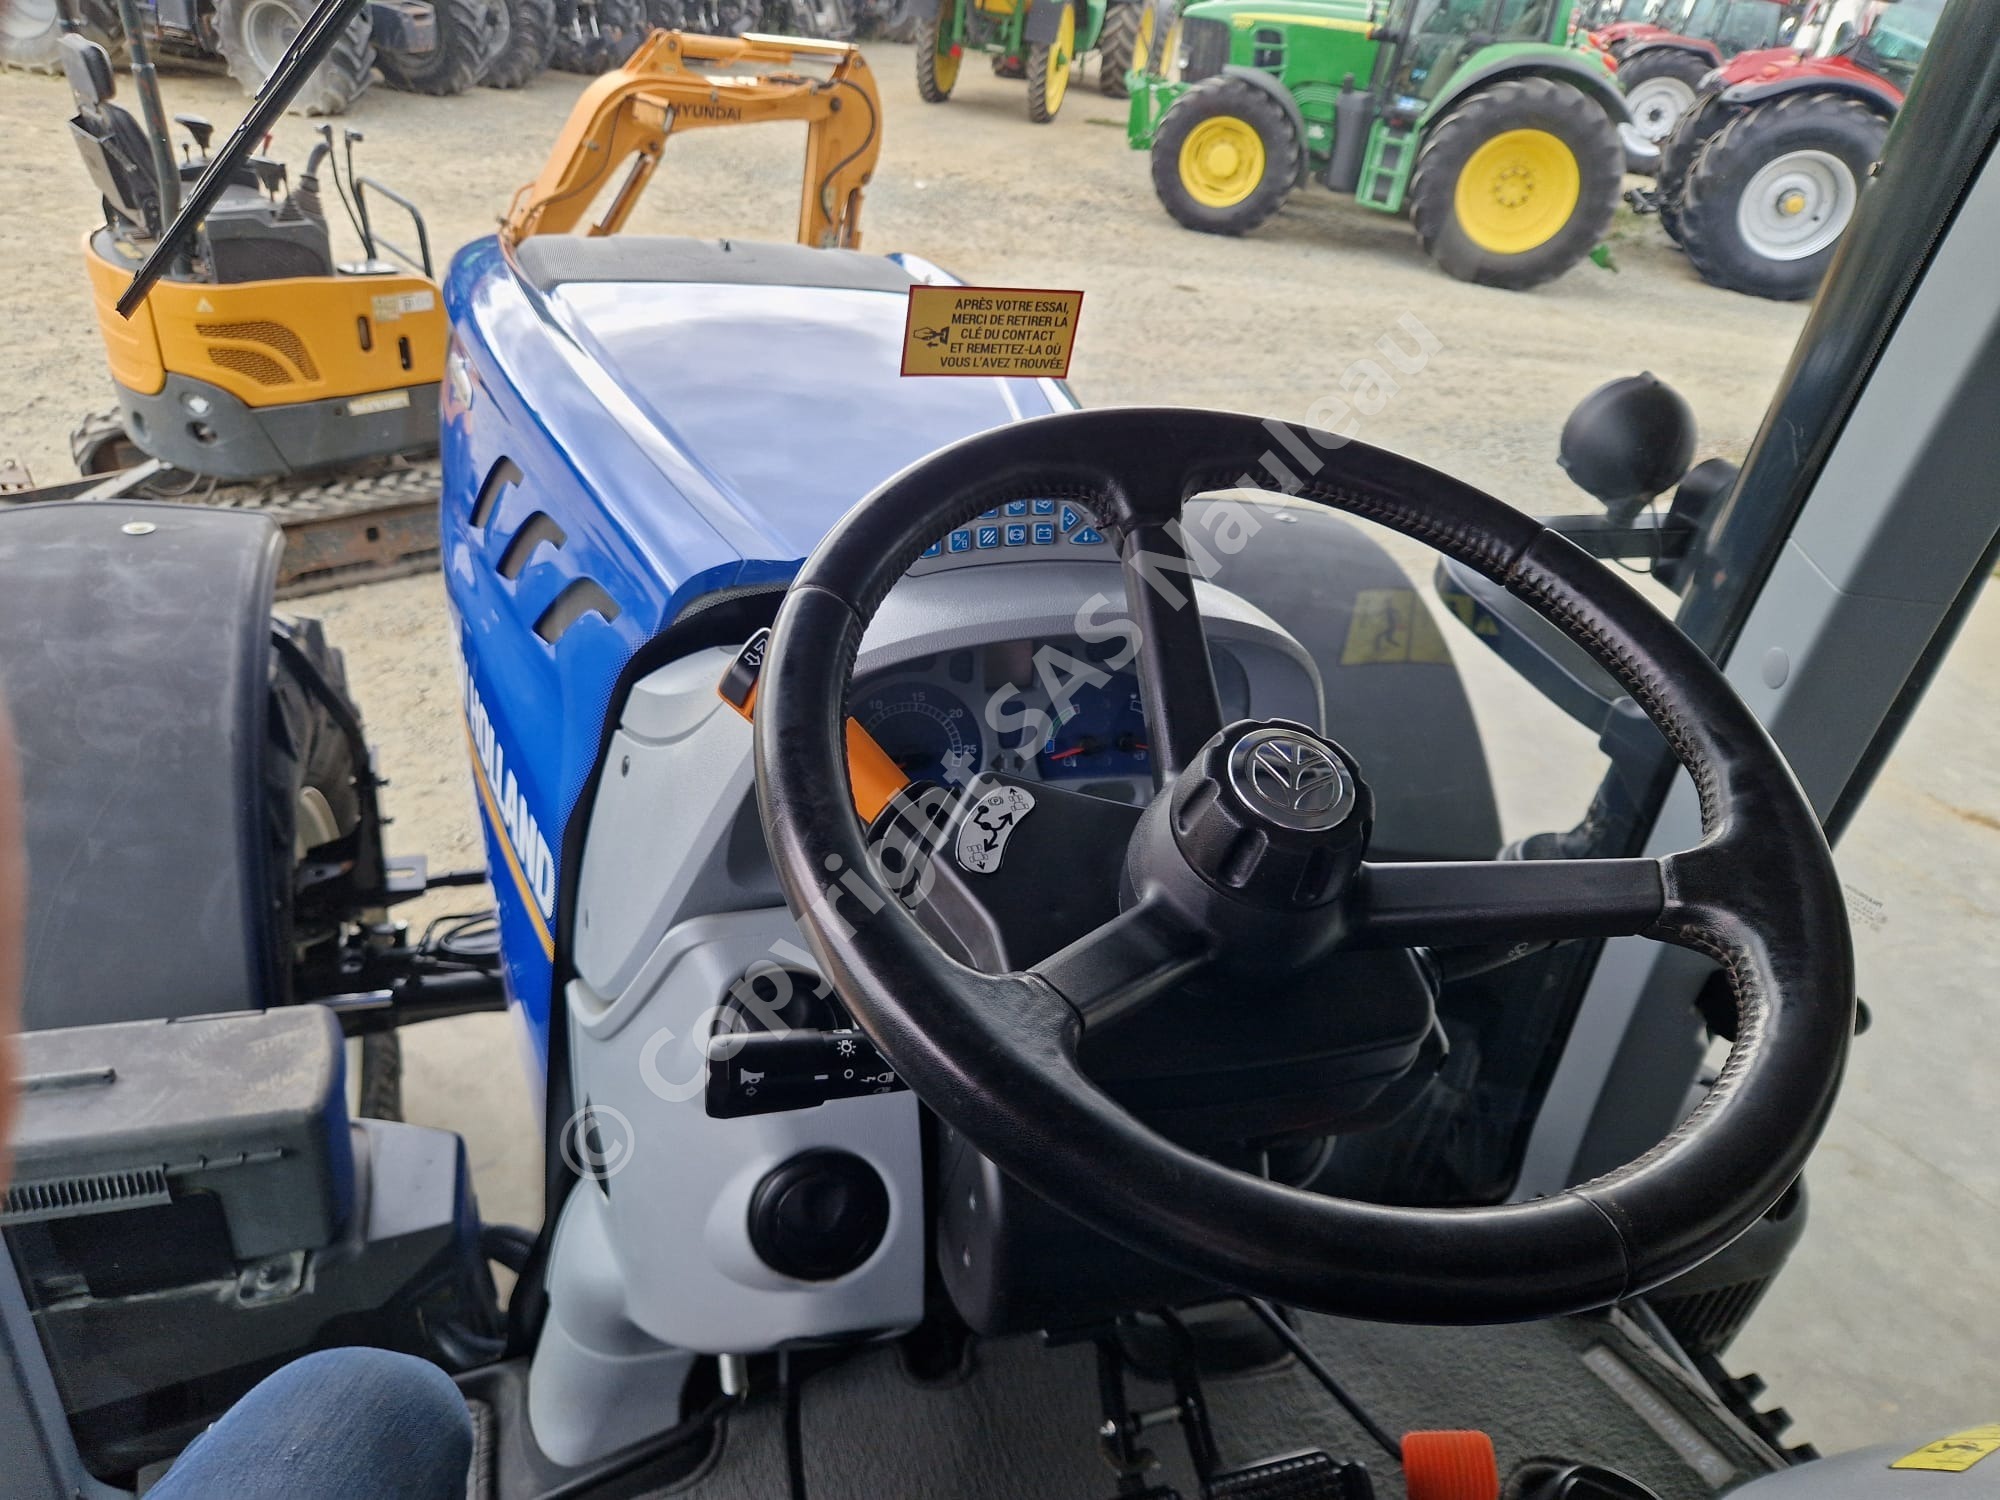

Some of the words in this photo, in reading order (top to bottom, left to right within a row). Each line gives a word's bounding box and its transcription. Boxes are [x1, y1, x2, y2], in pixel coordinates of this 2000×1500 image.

[955, 297, 993, 311] APRÈS
[995, 301, 1034, 312] VOTRE
[1034, 302, 1070, 315] ESSAI,
[951, 314, 987, 325] MERCI
[989, 315, 1004, 326] DE
[1006, 315, 1053, 327] RETIRER
[1054, 316, 1068, 327] LA
[960, 326, 982, 339] CLÉ
[984, 329, 1000, 340] DU
[1001, 329, 1055, 341] CONTACT
[950, 343, 964, 354] ET
[966, 343, 1042, 355] REMETTEZ-LA
[1045, 342, 1061, 355] OÙ
[940, 357, 970, 367] VOUS
[973, 357, 1010, 369] L'AVEZ
[1013, 355, 1065, 370] TROUVÉE.
[911, 691, 926, 702] 15
[869, 700, 883, 710] 10
[949, 708, 963, 719] 20
[963, 744, 977, 754] 25
[469, 673, 556, 920] HOLLAND
